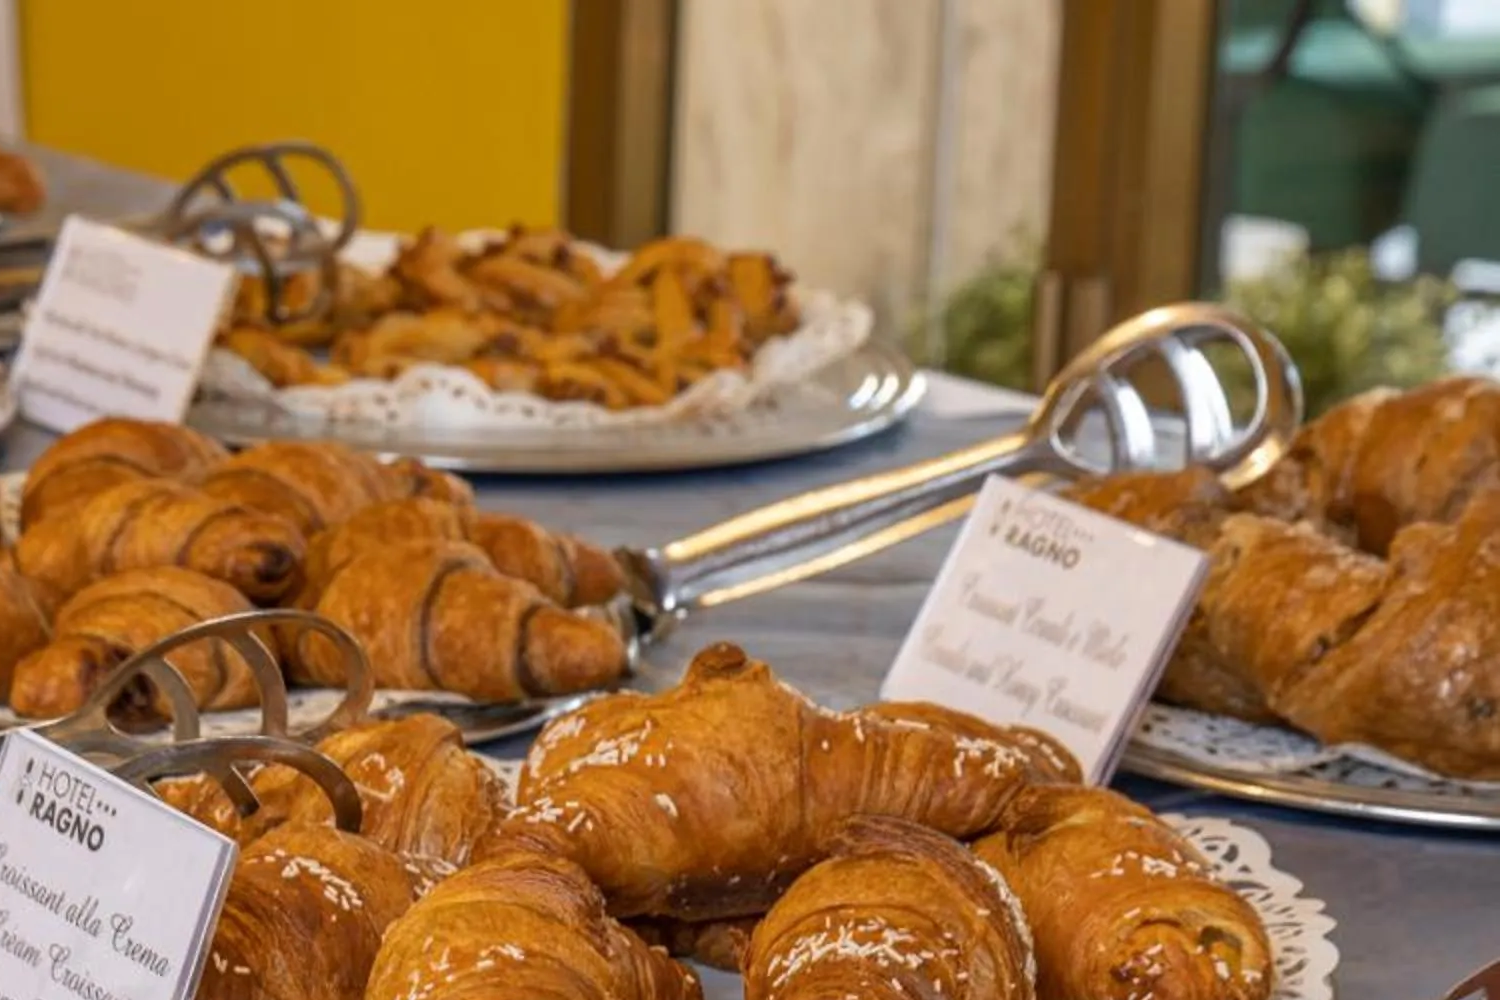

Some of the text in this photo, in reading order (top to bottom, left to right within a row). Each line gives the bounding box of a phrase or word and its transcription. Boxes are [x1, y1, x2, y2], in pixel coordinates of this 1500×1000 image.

[29, 790, 105, 852] RAGNO
[63, 895, 103, 939] alla
[110, 912, 170, 977] Crema
